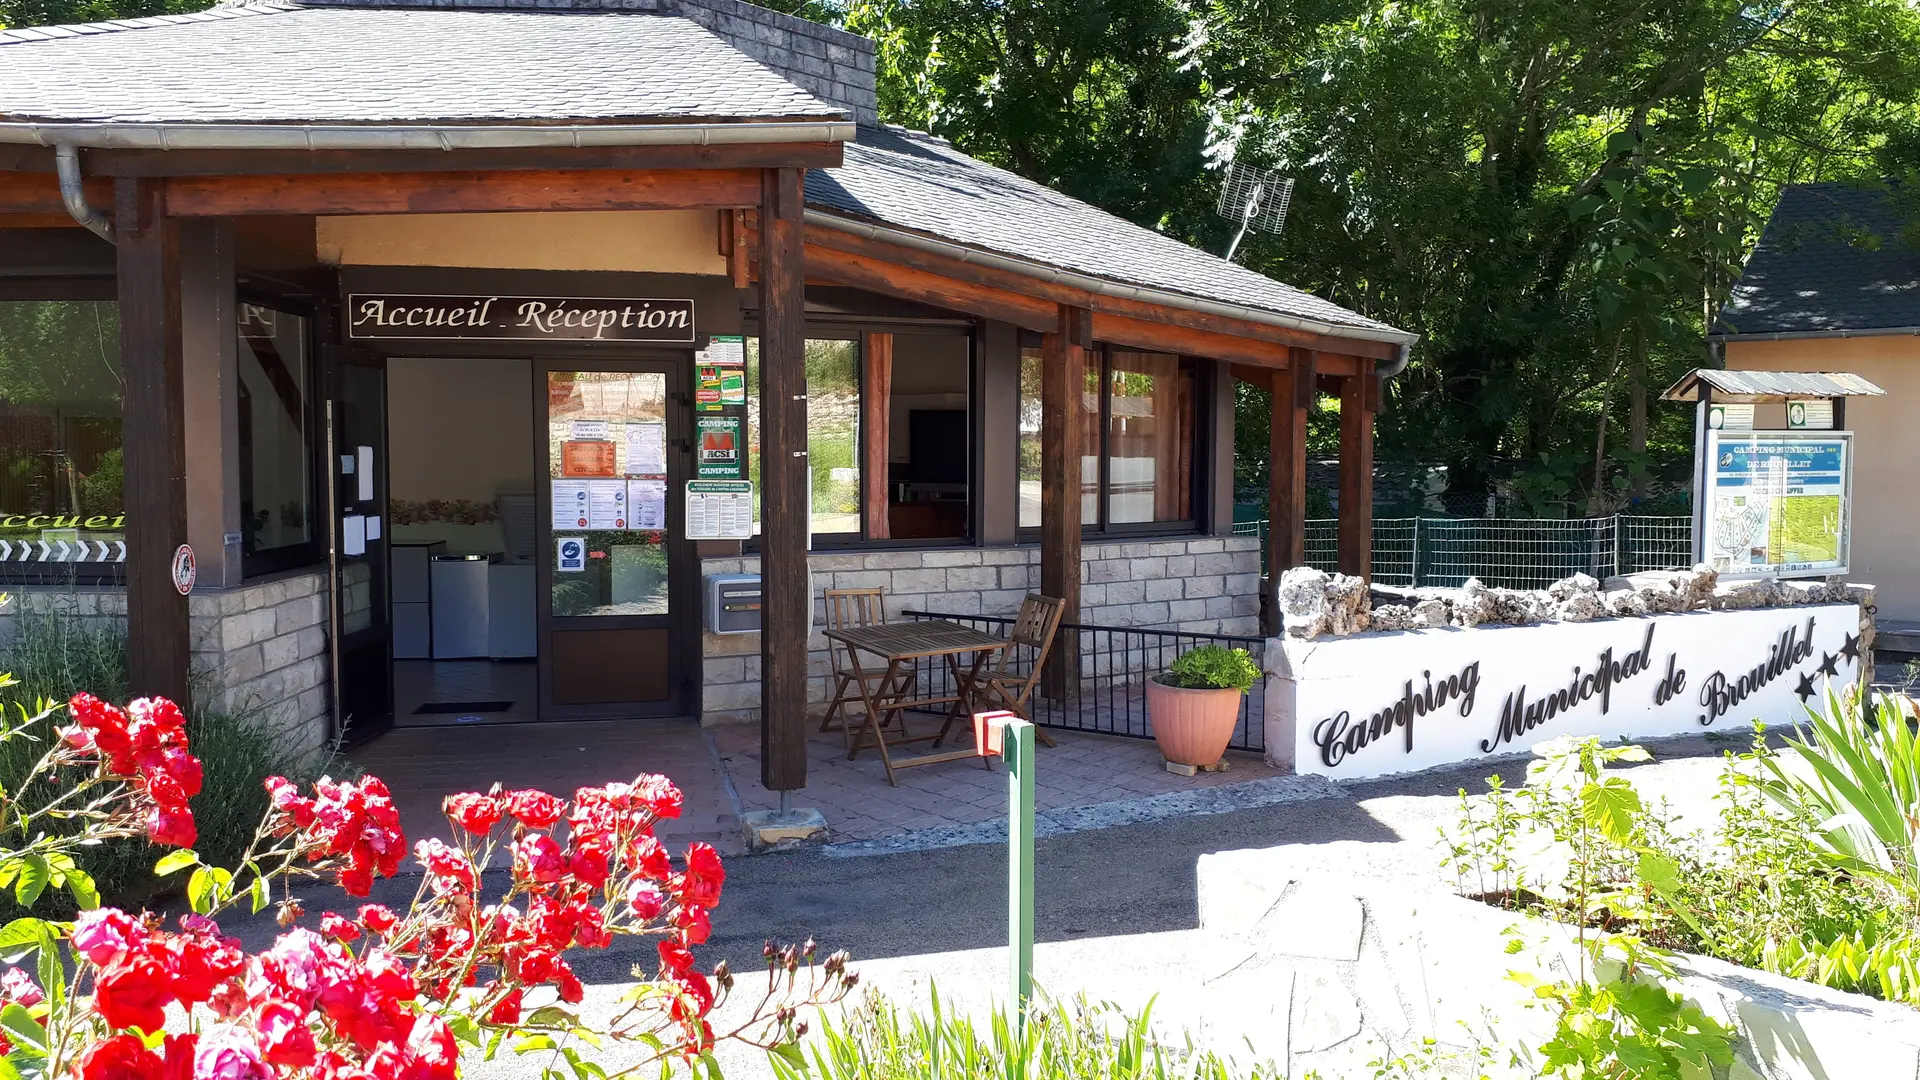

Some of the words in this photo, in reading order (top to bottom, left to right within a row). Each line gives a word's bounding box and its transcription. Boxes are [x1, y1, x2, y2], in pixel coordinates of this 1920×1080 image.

[353, 297, 498, 326] Accueil
[516, 300, 691, 339] Réception
[1733, 446, 1776, 454] CAMPING
[1776, 446, 1825, 454] MUNICIPAL
[1746, 460, 1758, 469] DE
[0, 511, 125, 528] ccuei
[1314, 660, 1480, 767] Camping
[1481, 622, 1655, 753] Municipal
[1655, 652, 1687, 707] de
[1699, 616, 1816, 727] Brouillet
